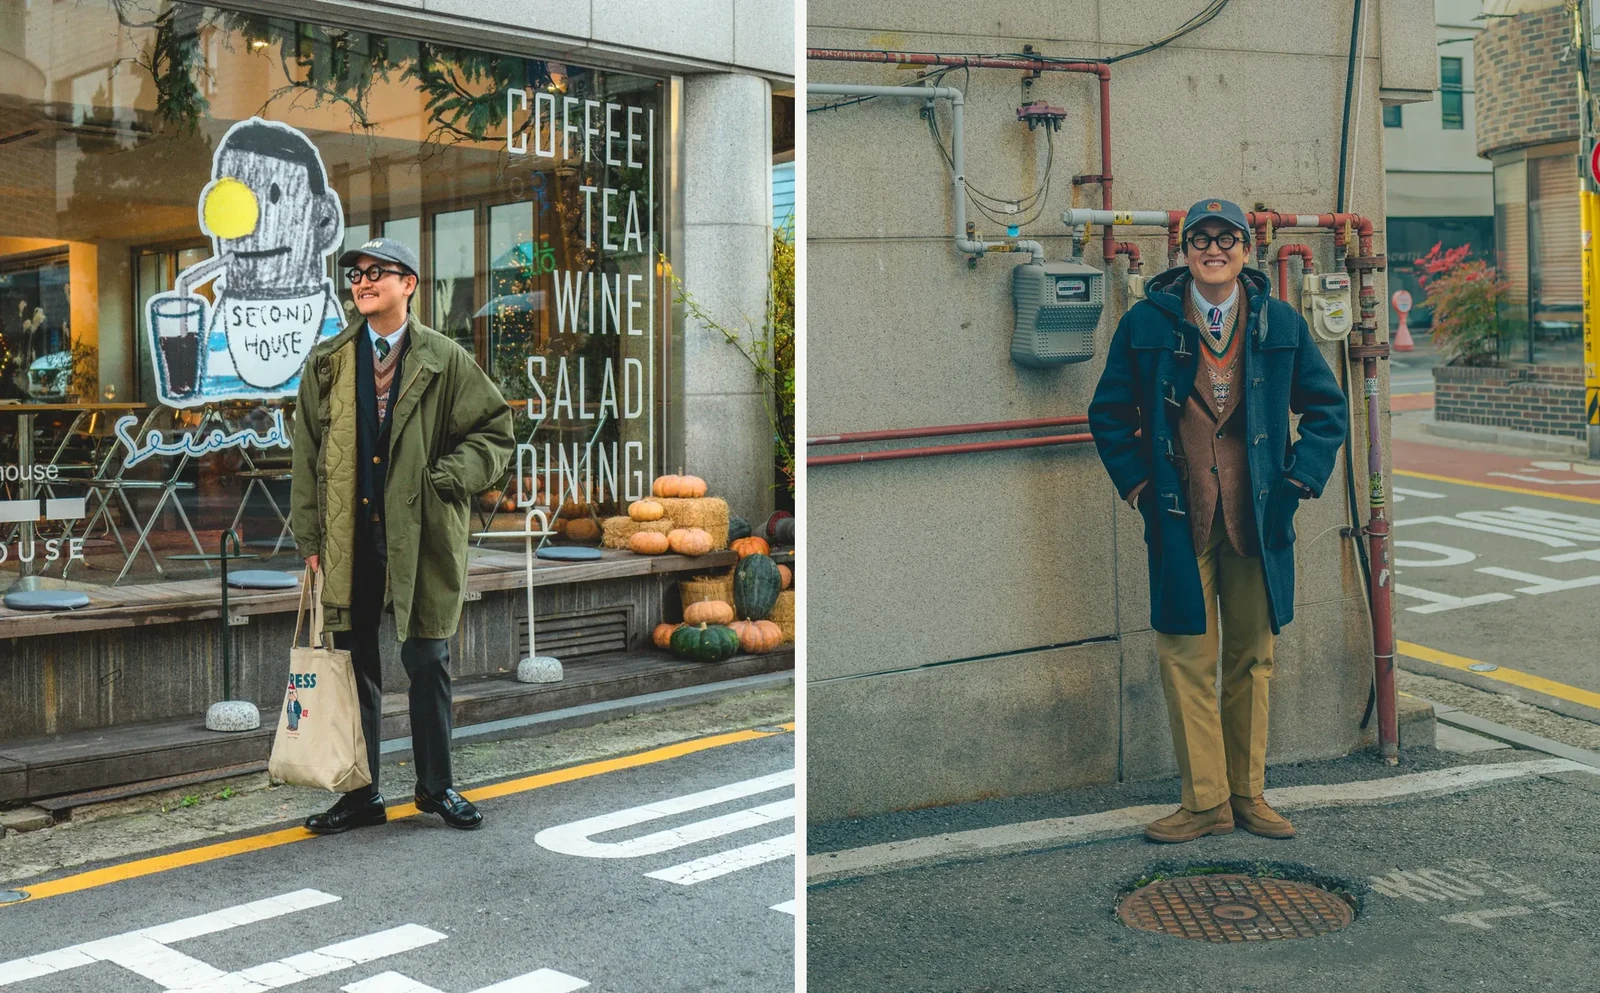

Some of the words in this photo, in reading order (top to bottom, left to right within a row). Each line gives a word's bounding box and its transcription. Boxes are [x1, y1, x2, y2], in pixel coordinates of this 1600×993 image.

[507, 88, 643, 169] COFFEE
[579, 185, 643, 253] TEA
[232, 303, 313, 328] SECOND
[553, 269, 643, 336] WINE
[244, 331, 302, 362] HOUSE
[527, 356, 643, 420] SALAD
[115, 410, 290, 468] Second
[516, 441, 643, 508] DINING
